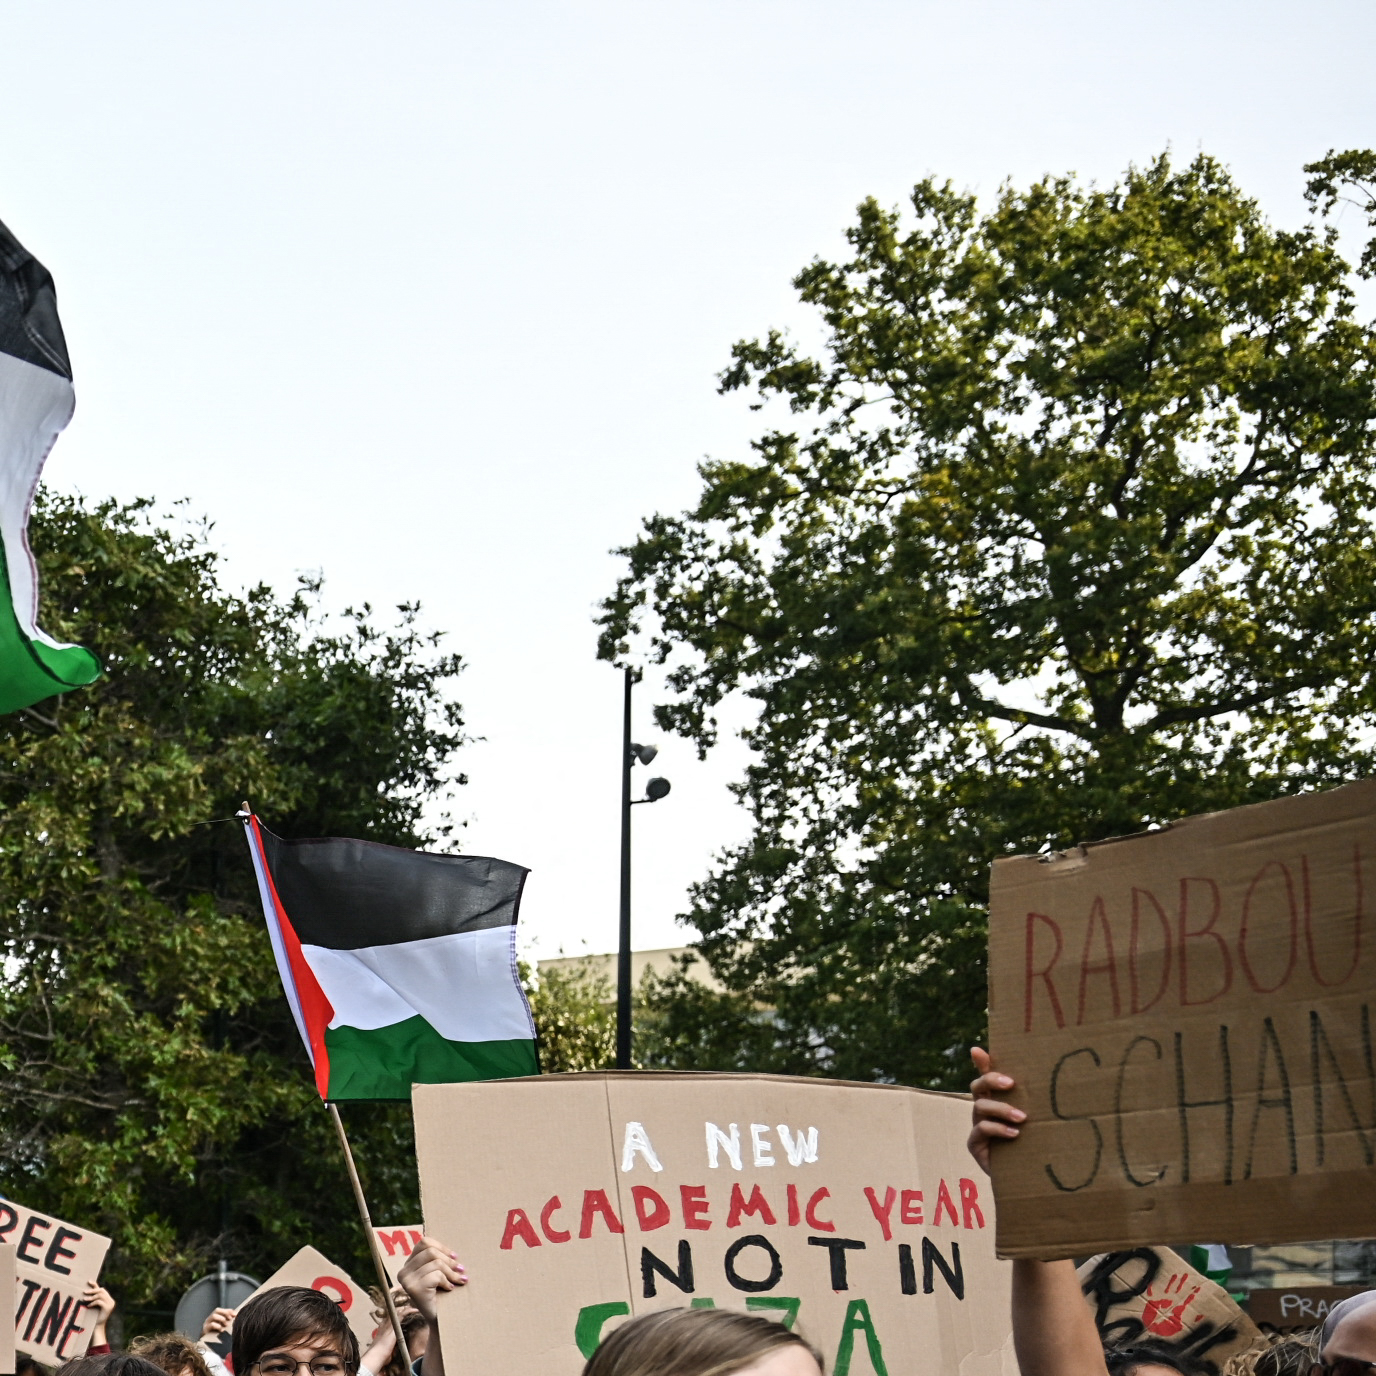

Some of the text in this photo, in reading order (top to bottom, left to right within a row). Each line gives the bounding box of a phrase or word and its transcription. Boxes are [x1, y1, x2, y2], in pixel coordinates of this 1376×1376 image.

[620, 1121, 819, 1173] A NEW
[499, 1182, 836, 1250] ACADEMIC
[863, 1177, 986, 1241] YEAR
[640, 1234, 965, 1301] NOT IN
